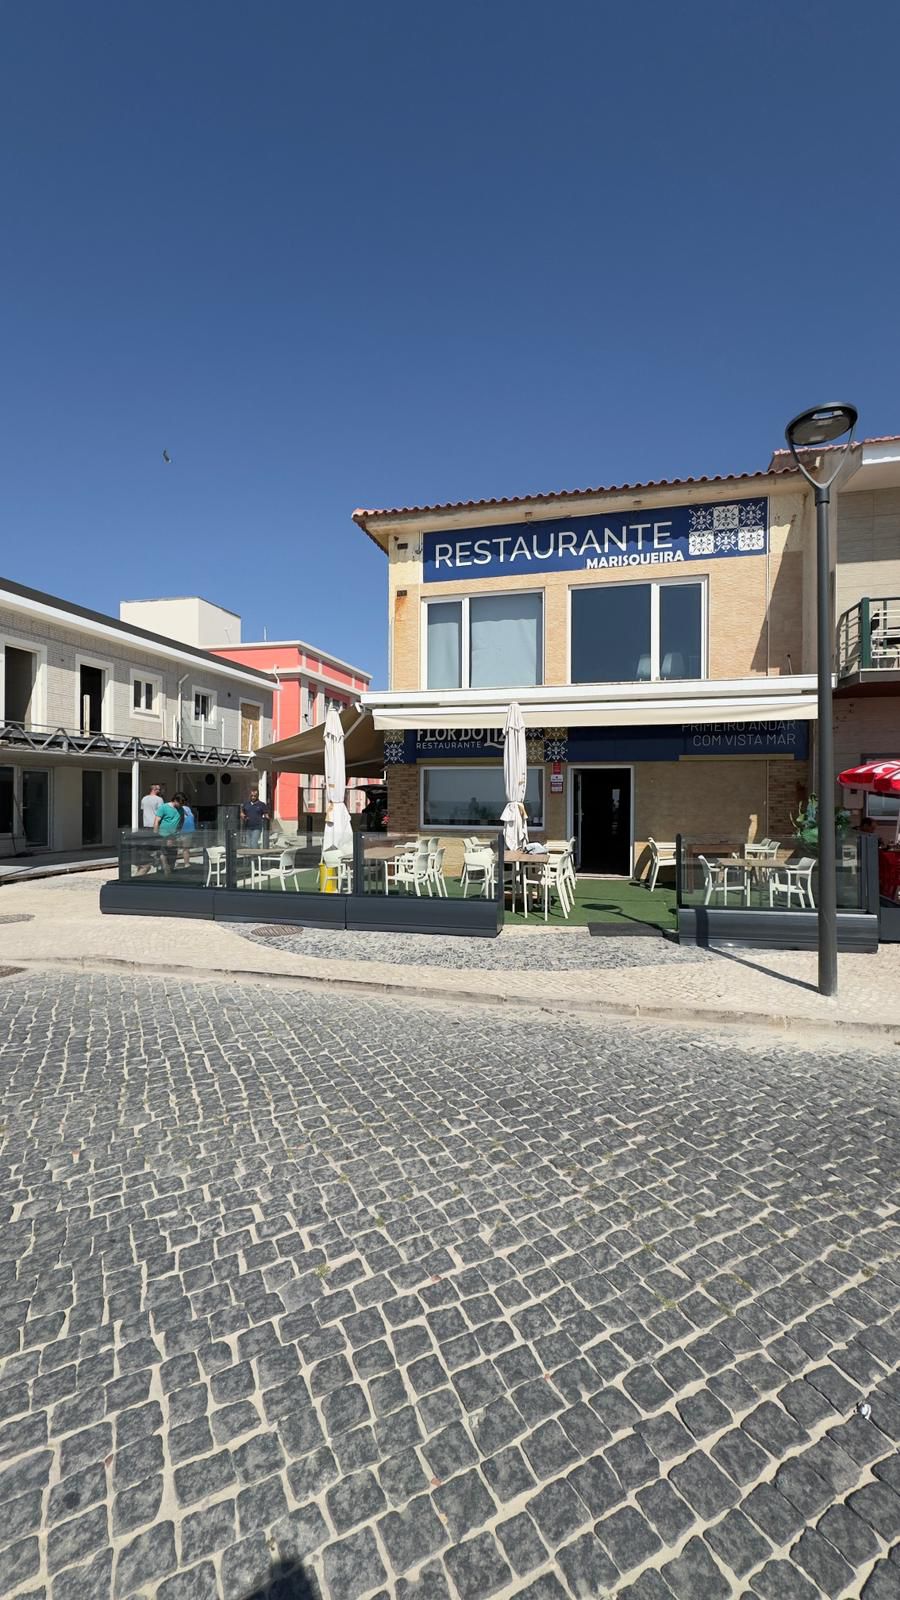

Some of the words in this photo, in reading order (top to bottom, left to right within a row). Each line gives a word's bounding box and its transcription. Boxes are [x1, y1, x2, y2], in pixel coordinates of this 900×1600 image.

[435, 521, 673, 569] RESTAURANTE
[586, 549, 685, 569] MARISQUEIRA
[681, 721, 746, 732] PRIMEIRO
[748, 719, 796, 731] ANDAR
[416, 728, 457, 742] FLOR
[459, 728, 484, 741] DO
[692, 734, 721, 747] COM
[724, 733, 763, 746] VISTA
[766, 733, 796, 745] MAR
[416, 741, 482, 750] RESTAURANTE
